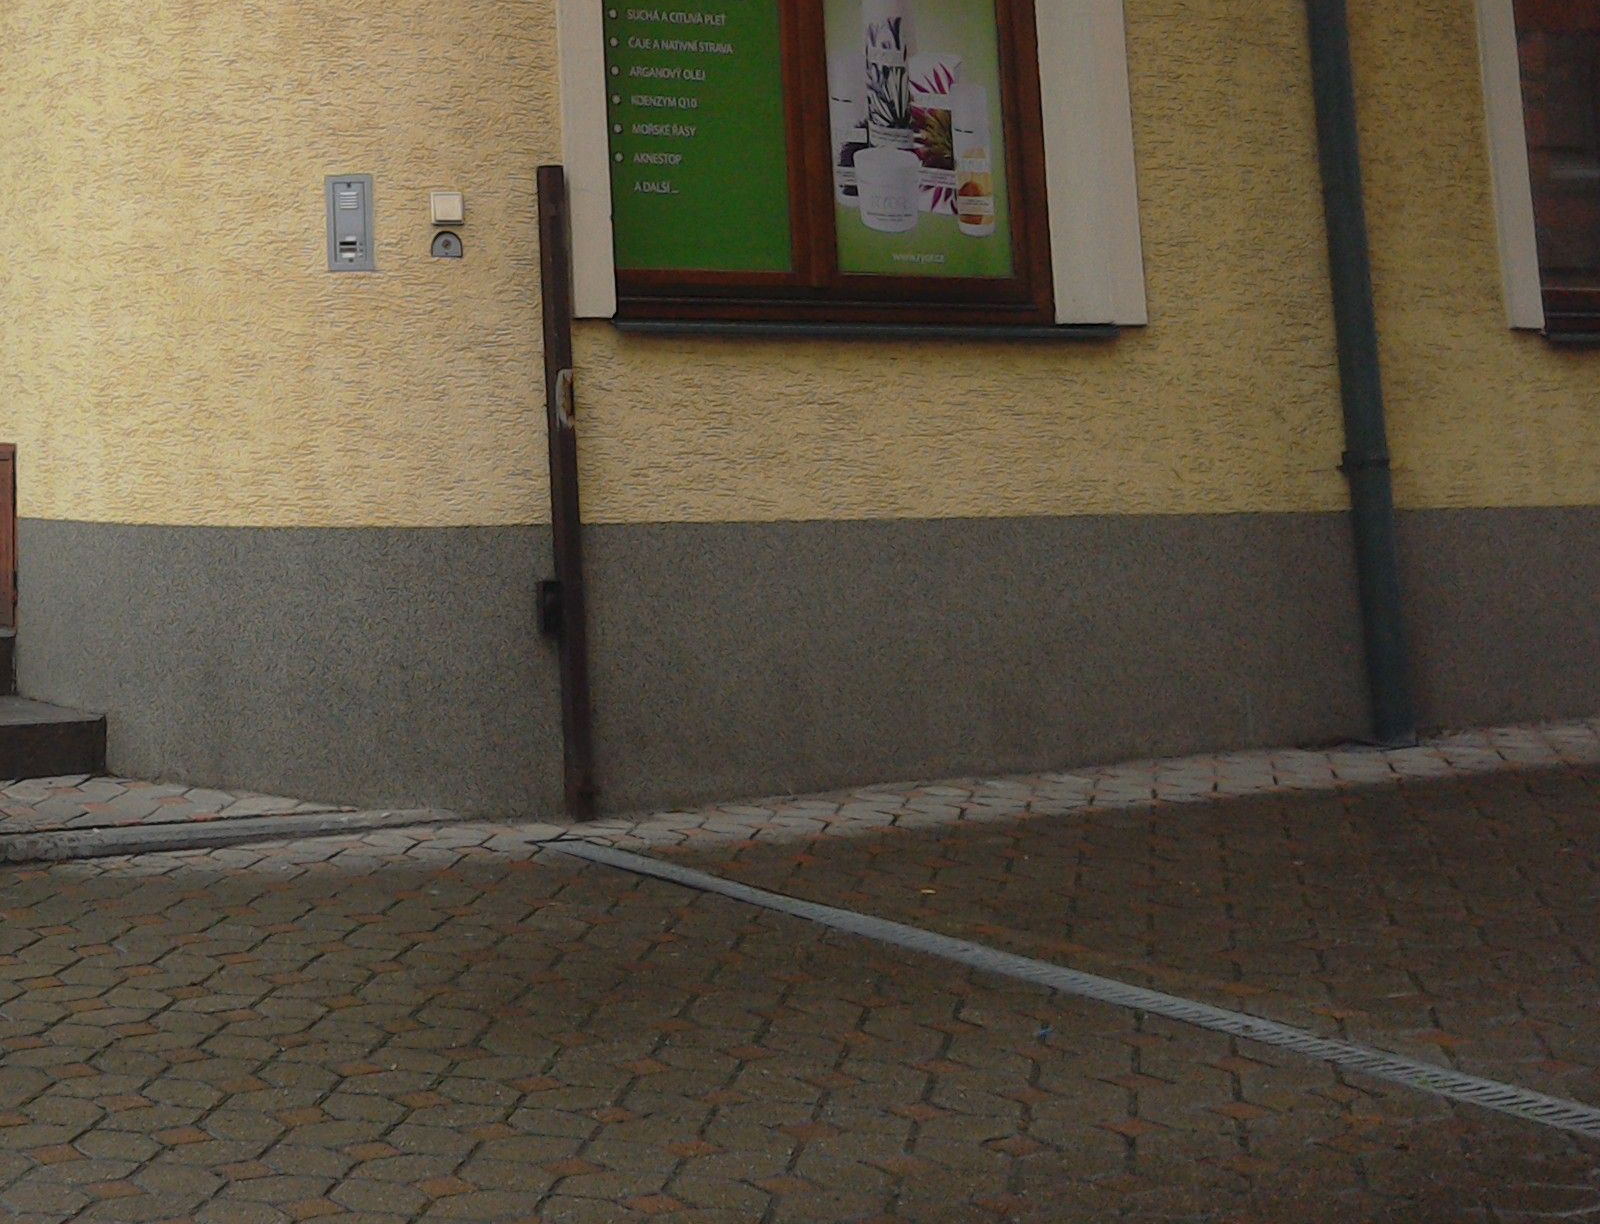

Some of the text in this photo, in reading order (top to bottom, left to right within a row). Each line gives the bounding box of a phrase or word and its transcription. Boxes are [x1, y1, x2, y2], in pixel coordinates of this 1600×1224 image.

[683, 69, 706, 82] OLEJ
[677, 98, 698, 109] Q10
[633, 152, 682, 166] AKNESTOP
[633, 182, 641, 193] A
